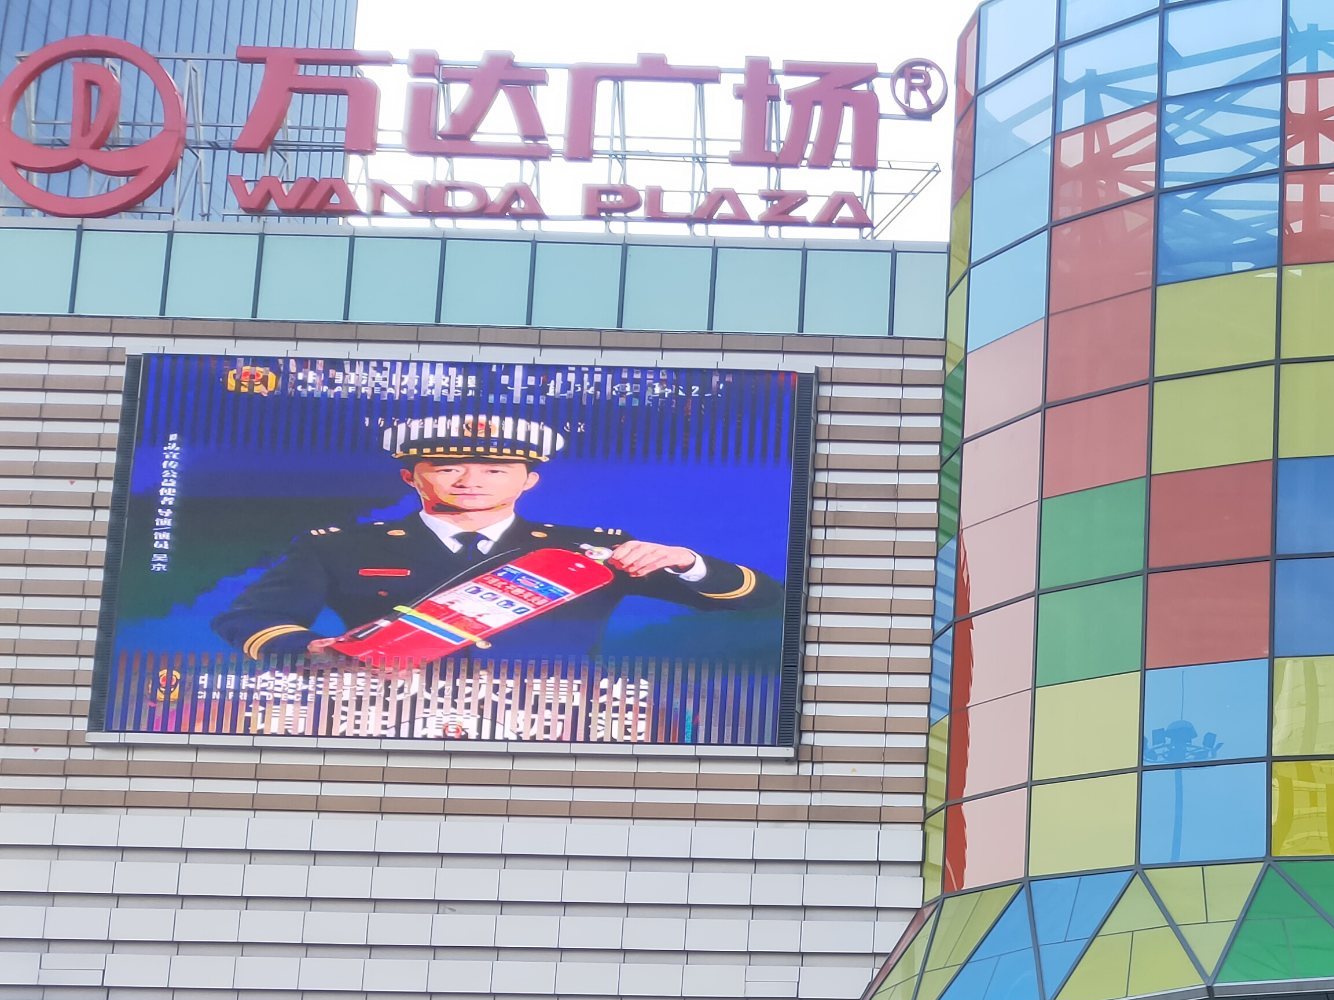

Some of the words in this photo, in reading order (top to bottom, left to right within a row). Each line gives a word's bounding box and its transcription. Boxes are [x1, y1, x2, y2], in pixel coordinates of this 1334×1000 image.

[235, 46, 880, 172] 万达广场
[228, 174, 549, 220] WANDA
[582, 183, 878, 229] PLAZA
